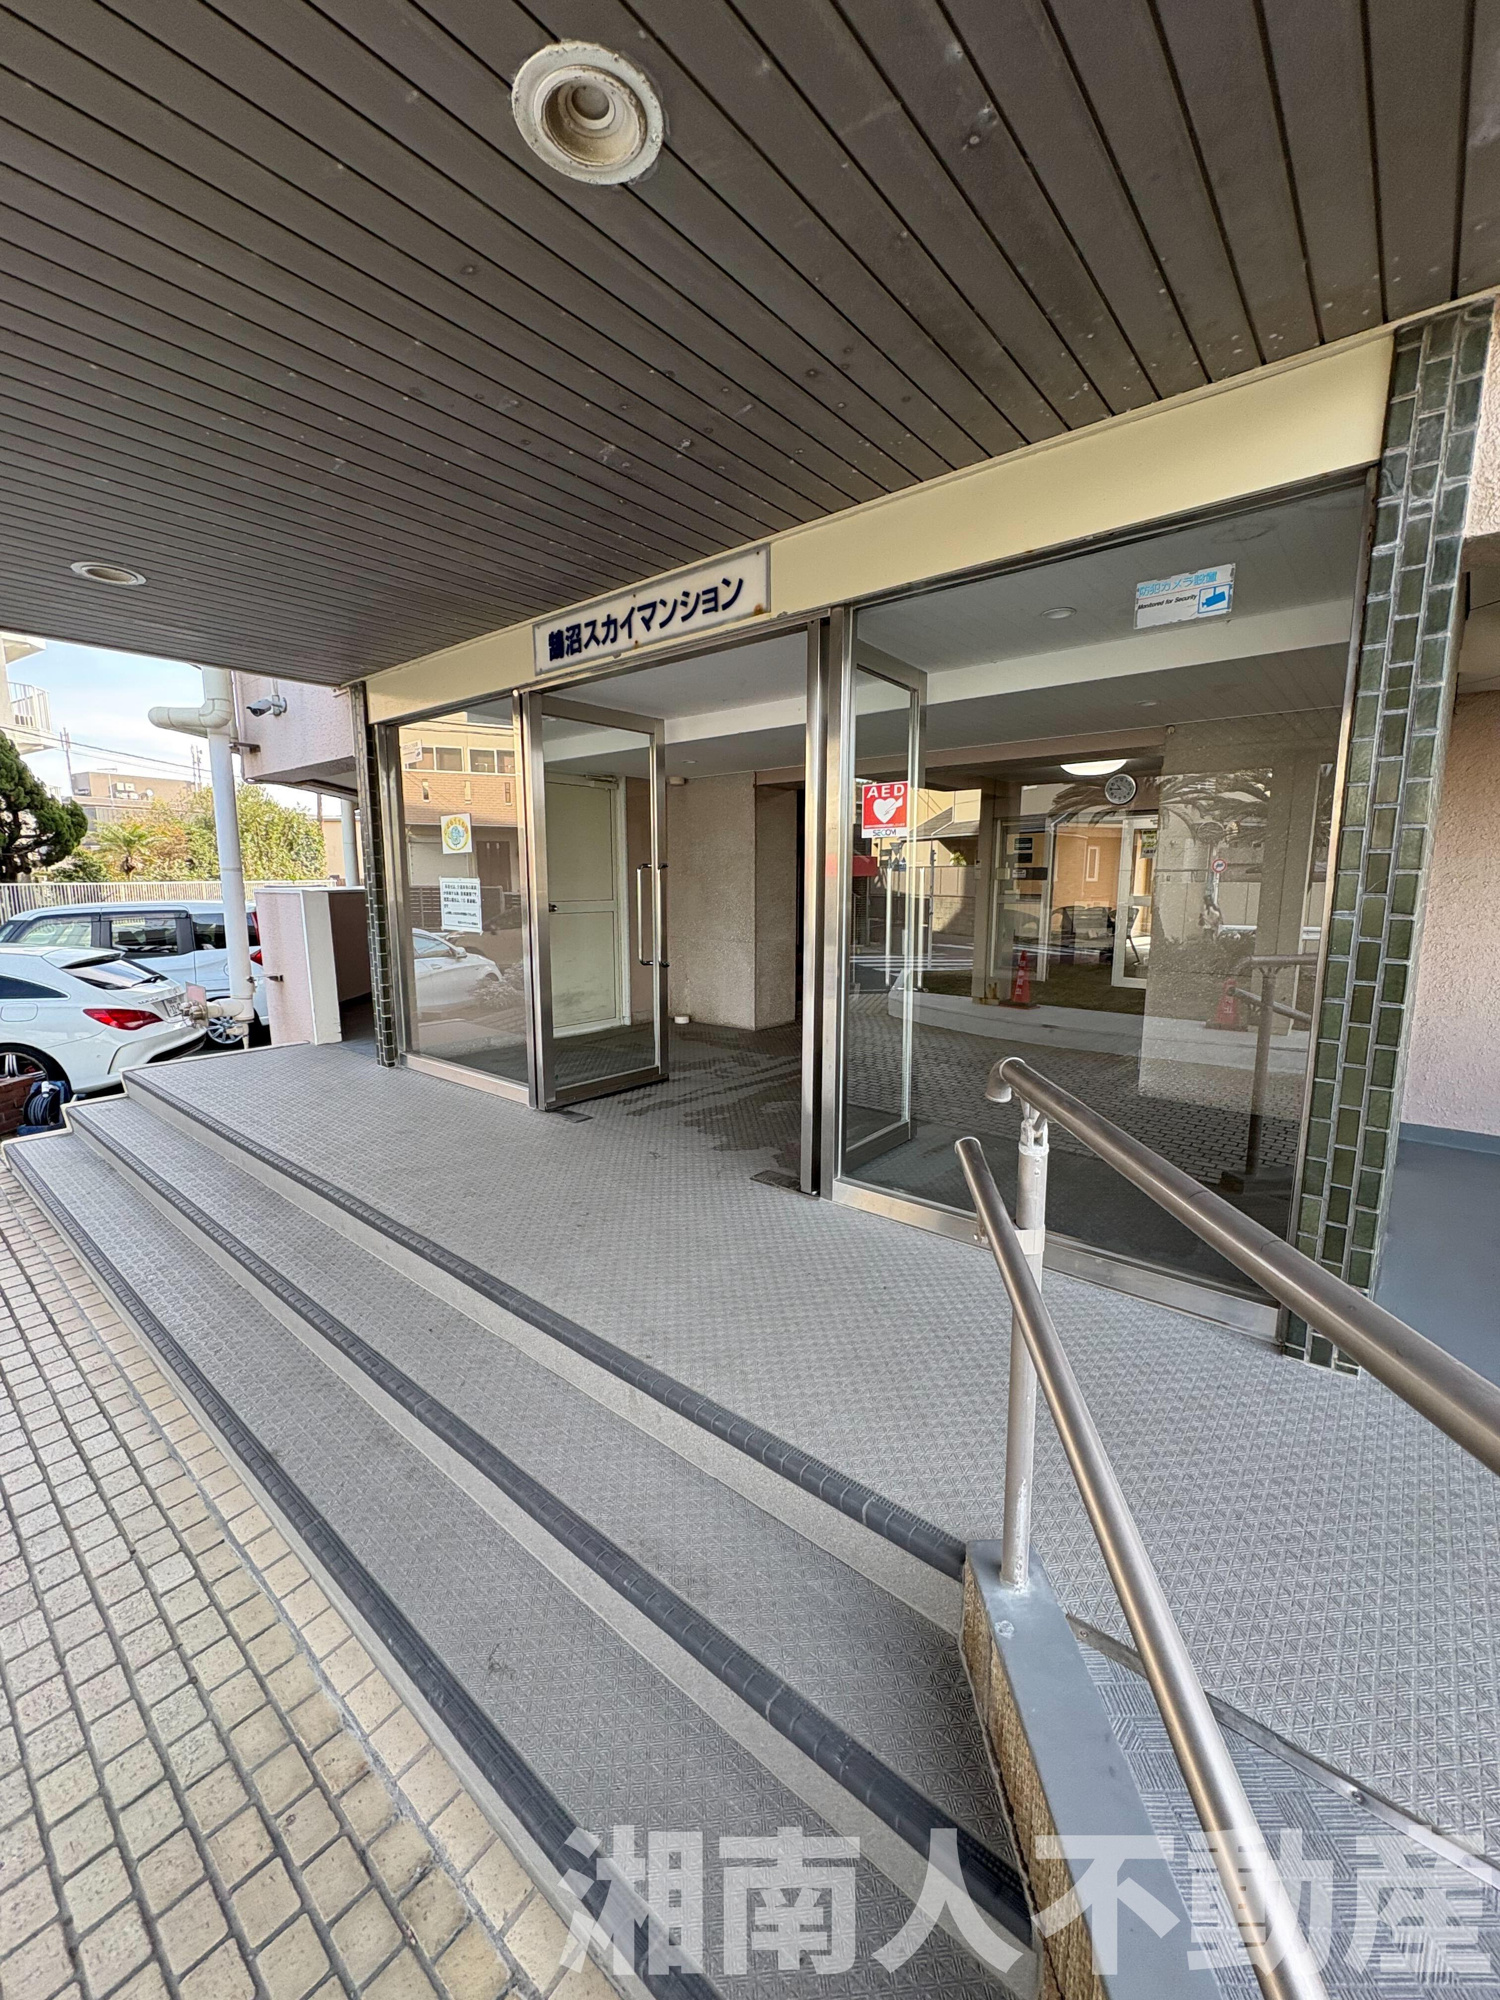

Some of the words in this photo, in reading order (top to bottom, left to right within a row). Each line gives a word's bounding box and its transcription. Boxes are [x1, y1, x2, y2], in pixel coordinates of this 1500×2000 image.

[1137, 600, 1164, 610] Monitored
[1174, 594, 1197, 603] Security
[866, 784, 905, 799] AED
[872, 829, 897, 837] SECOM
